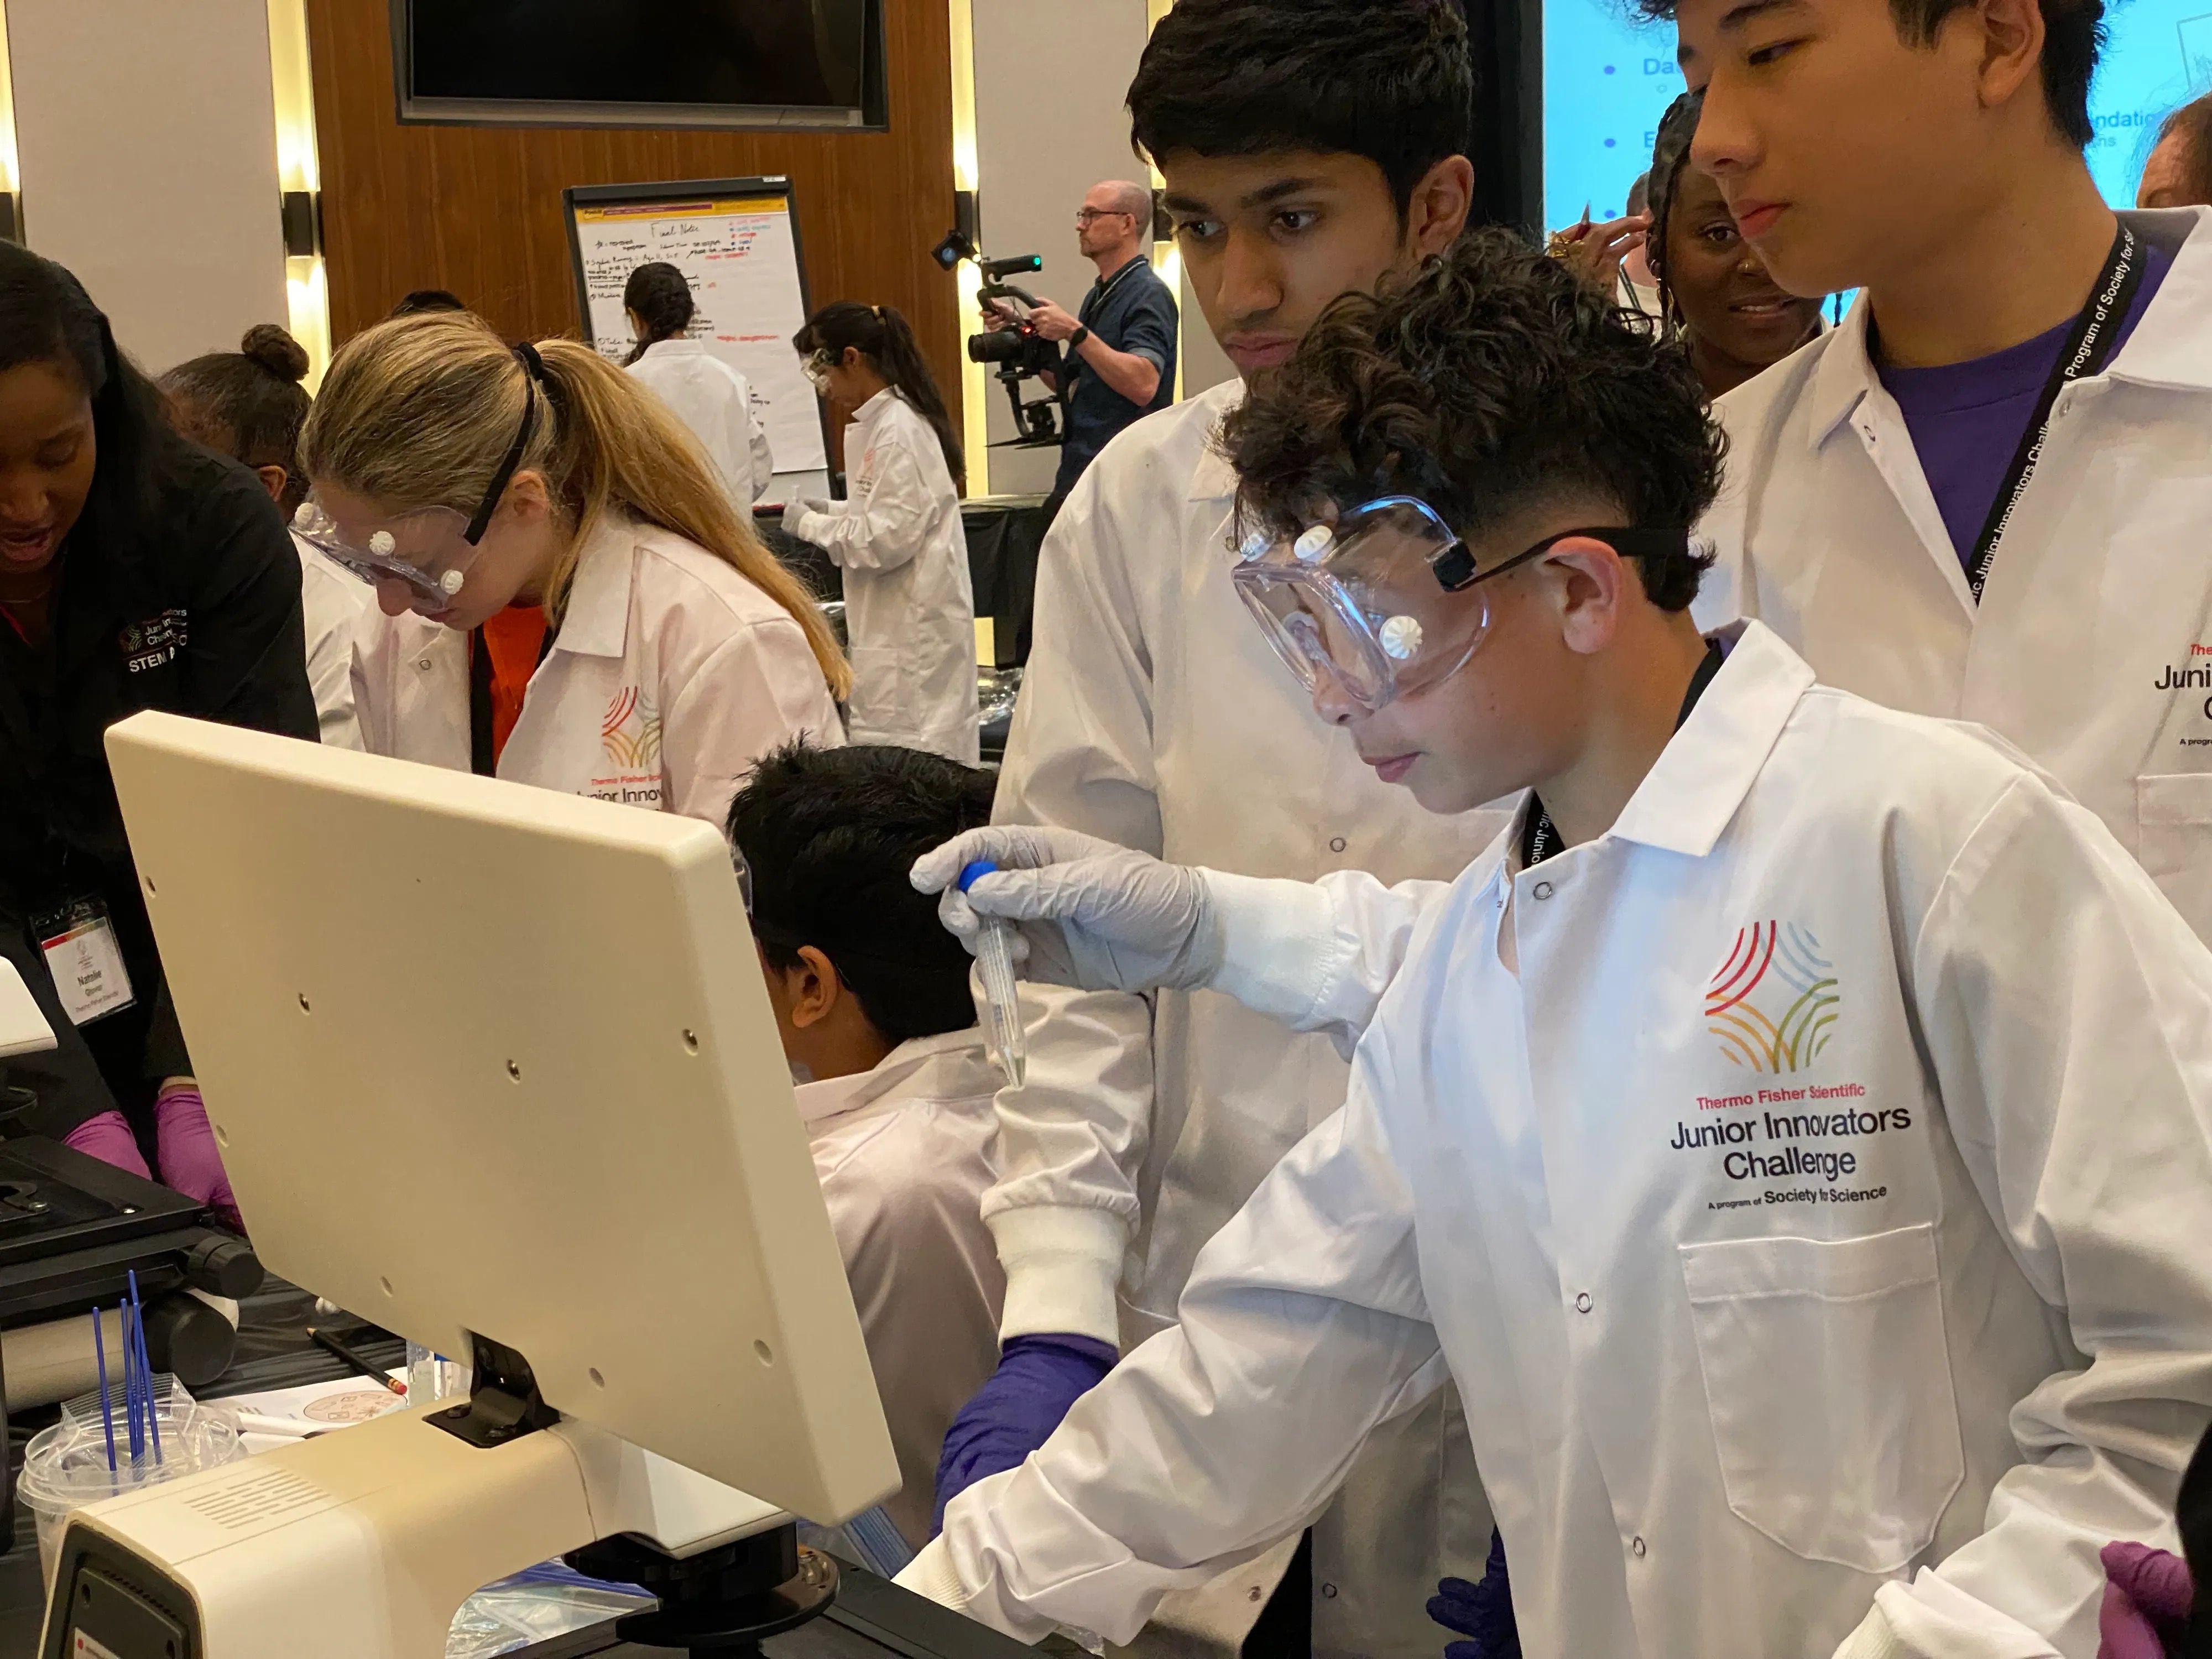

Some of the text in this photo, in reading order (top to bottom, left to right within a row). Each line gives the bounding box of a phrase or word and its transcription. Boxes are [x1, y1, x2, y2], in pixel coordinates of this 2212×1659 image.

[2120, 244, 2135, 260] for
[2100, 260, 2132, 306] Society
[2095, 304, 2109, 322] of
[2064, 323, 2101, 378] Program
[2154, 663, 2211, 690] Juni
[1696, 1083, 1866, 1110] Thermo Fisher Scientific
[1671, 1107, 1912, 1149] Junior Innovators
[1723, 1146, 1856, 1182] Challenge
[1709, 1201, 1715, 1210] A
[1716, 1199, 1751, 1210] program
[1753, 1197, 1762, 1206] of
[1764, 1188, 1817, 1204] Society
[1829, 1185, 1887, 1203] Science
